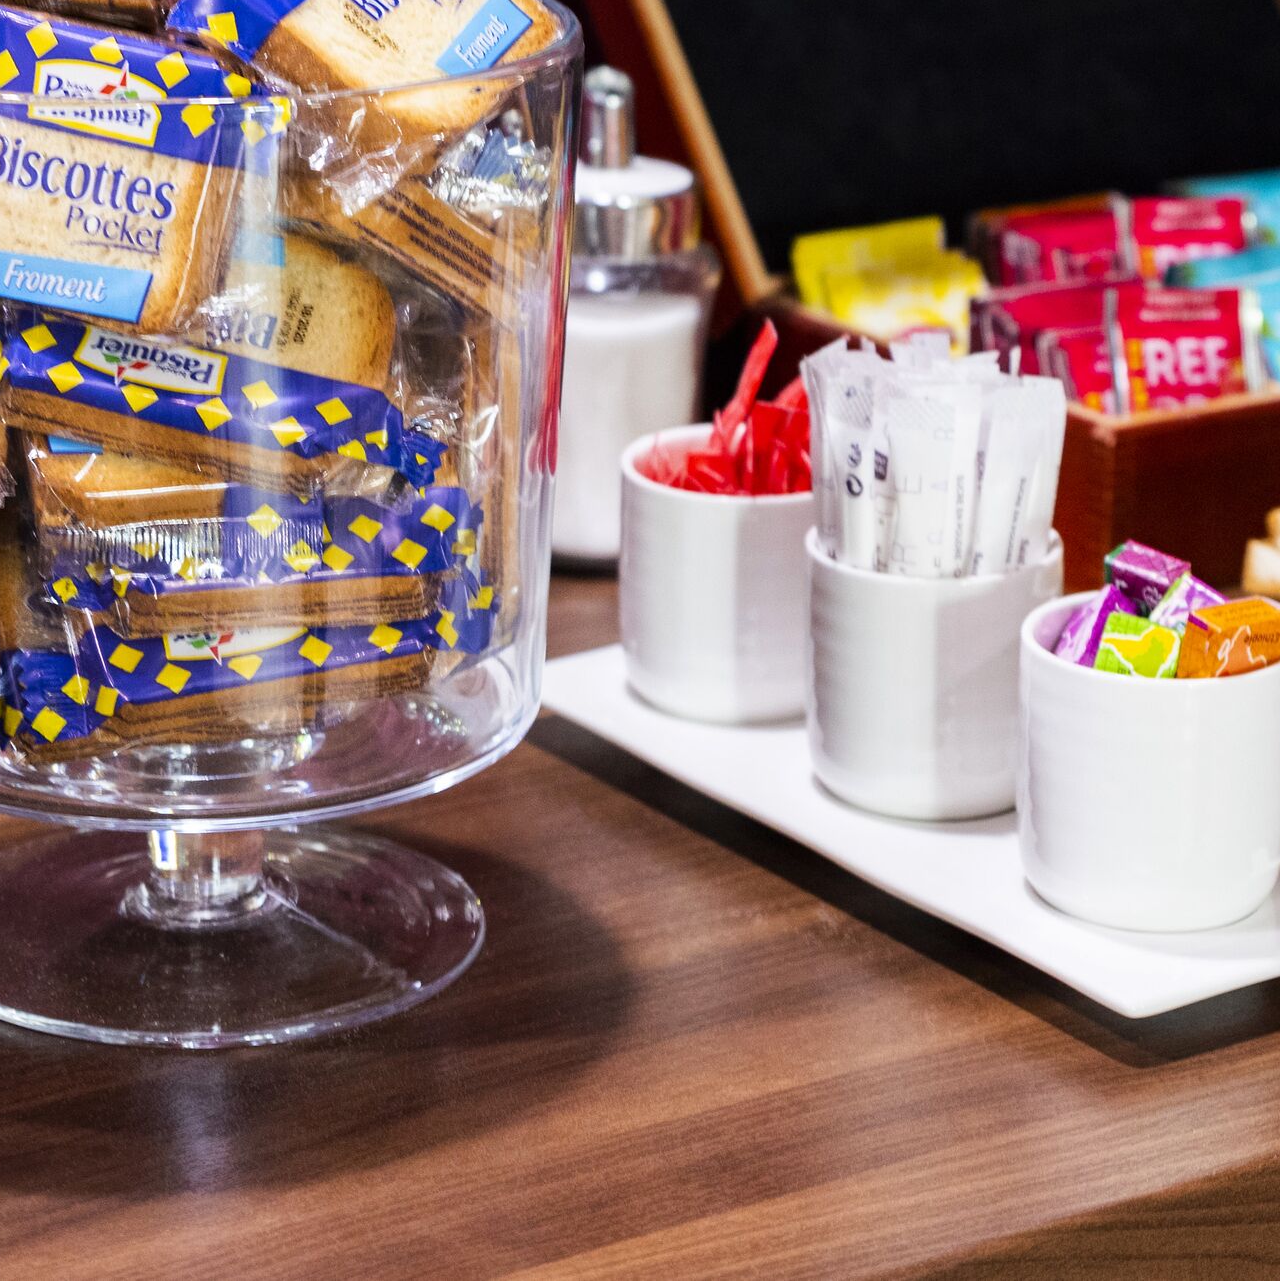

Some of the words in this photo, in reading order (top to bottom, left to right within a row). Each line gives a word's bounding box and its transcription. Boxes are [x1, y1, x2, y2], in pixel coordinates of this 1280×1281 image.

[455, 13, 509, 70] Froment
[66, 205, 164, 250] Pocket
[3, 258, 107, 303] Froment
[89, 332, 214, 384] Pasquier
